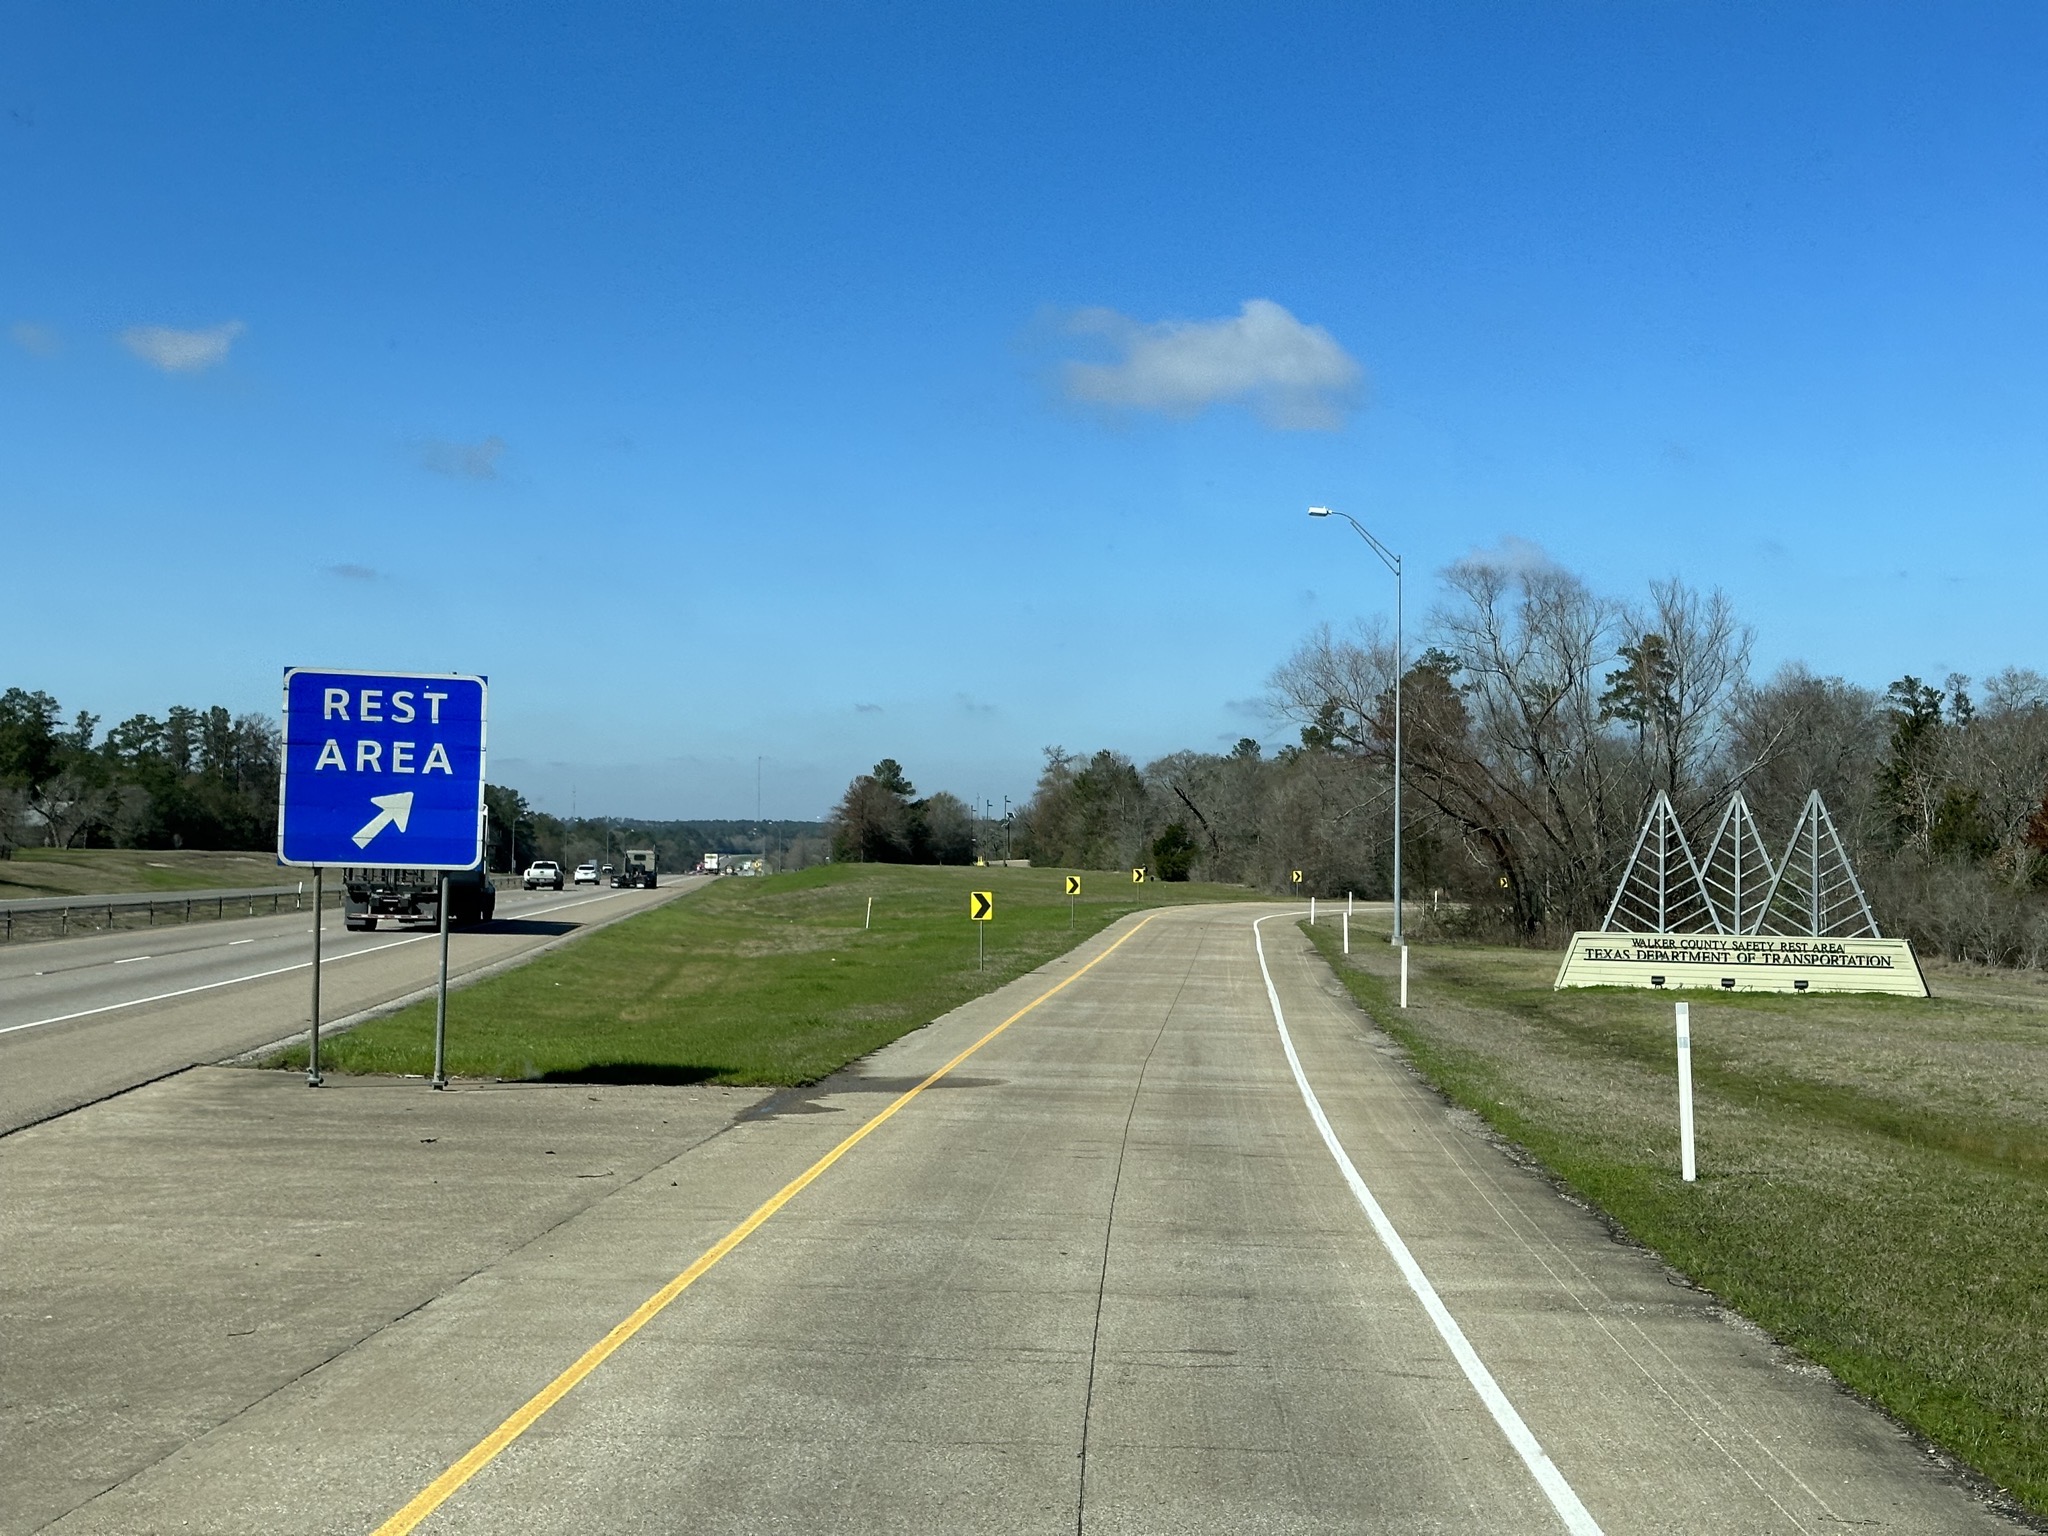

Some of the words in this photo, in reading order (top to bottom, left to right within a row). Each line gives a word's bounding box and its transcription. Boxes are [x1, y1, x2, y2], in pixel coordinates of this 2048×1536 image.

[324, 688, 448, 724] REST
[315, 739, 453, 775] AREA
[1585, 949, 1630, 960] TEXAS
[1636, 950, 1730, 962] DEPARTMENT
[1737, 952, 1755, 963] OF
[1762, 953, 1891, 967] TRANSPORTATION
[1632, 938, 1676, 949] WALKER
[1680, 939, 1727, 950] COUNTY
[1732, 940, 1774, 951] SAFETY
[1780, 942, 1808, 952] REST
[1813, 944, 1844, 954] AREA
